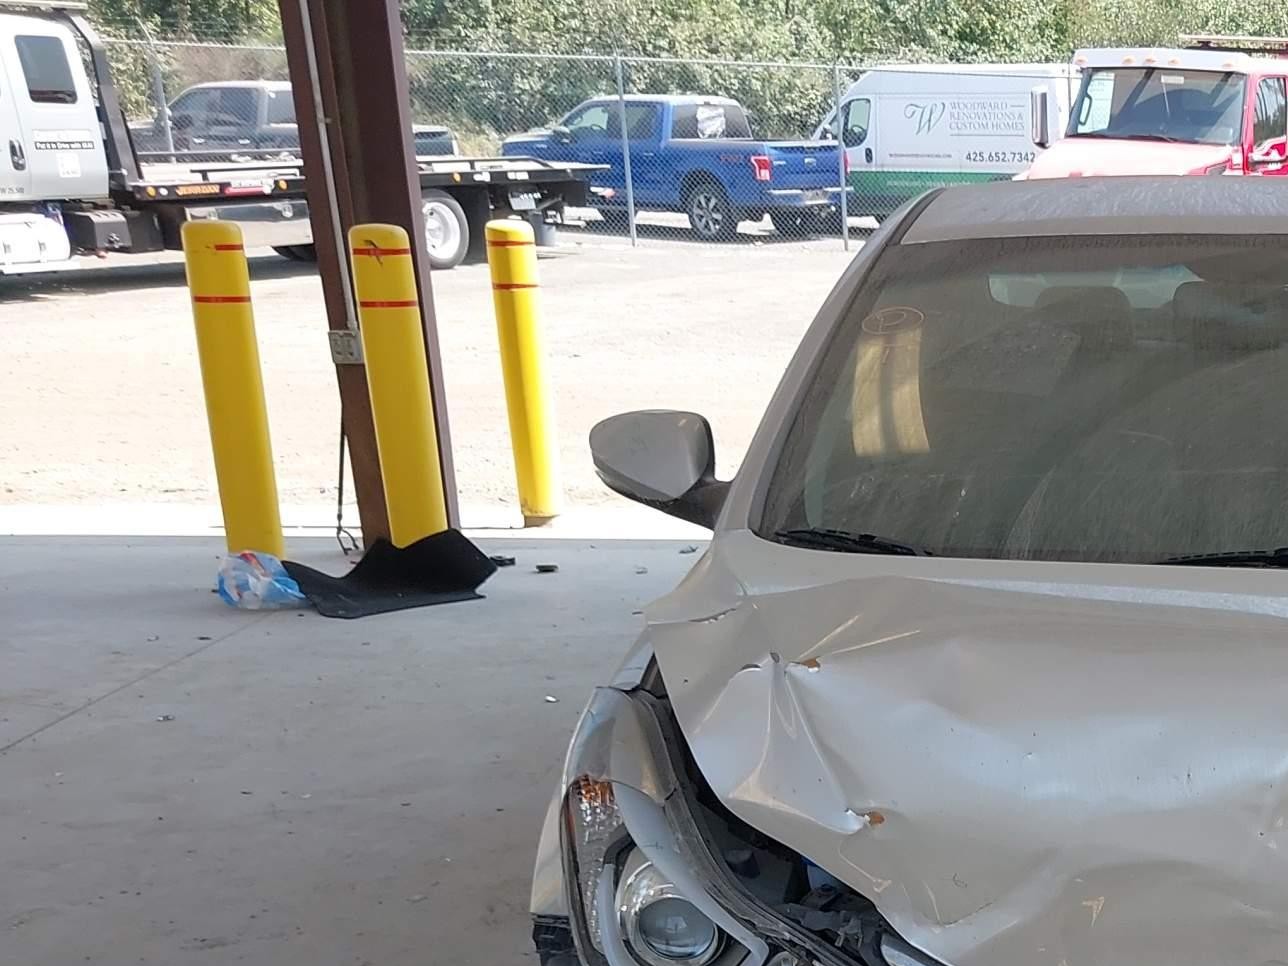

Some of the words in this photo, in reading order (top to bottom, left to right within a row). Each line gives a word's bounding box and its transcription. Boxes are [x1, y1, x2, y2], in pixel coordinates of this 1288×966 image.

[949, 101, 1008, 111] WOODWARD
[949, 112, 1016, 121] RENOVATIONS
[949, 121, 987, 131] CUSTOM
[991, 122, 1024, 131] HOMES
[965, 151, 1036, 163] 425.652.7342
